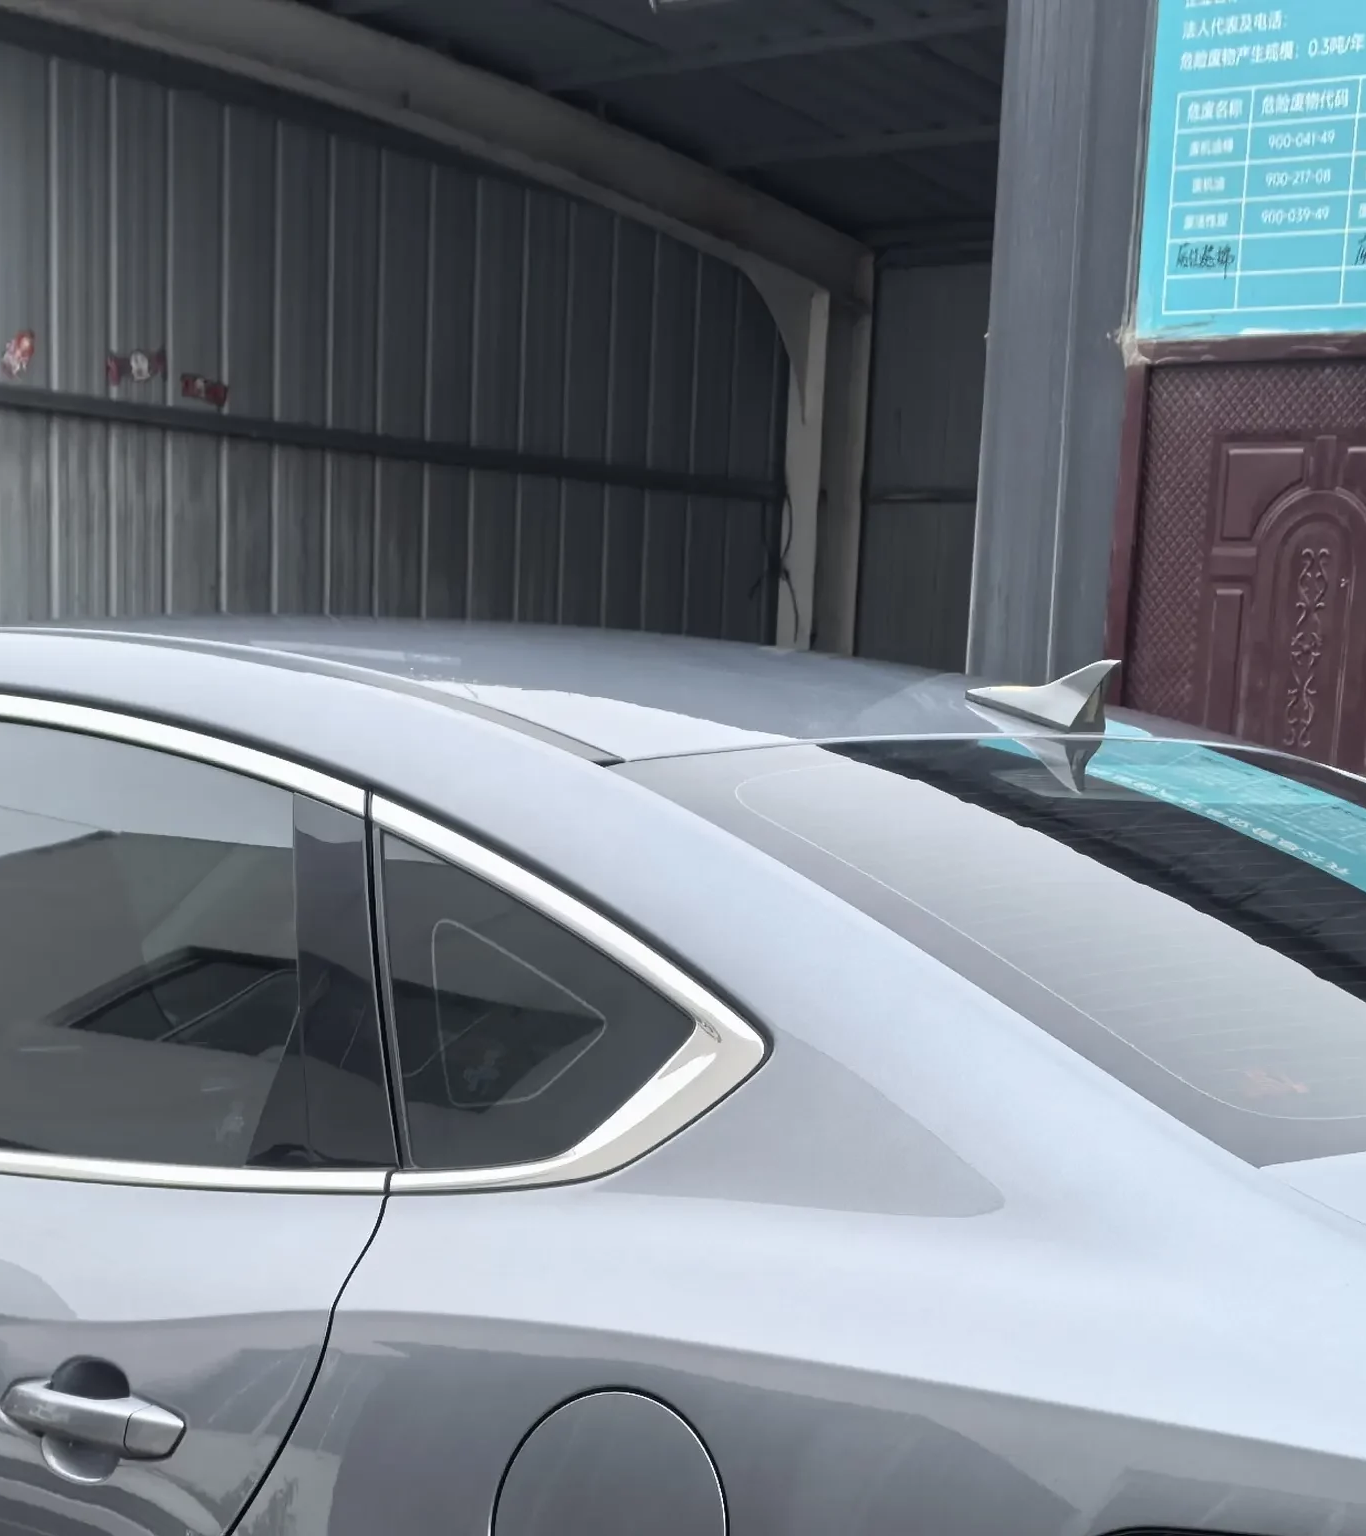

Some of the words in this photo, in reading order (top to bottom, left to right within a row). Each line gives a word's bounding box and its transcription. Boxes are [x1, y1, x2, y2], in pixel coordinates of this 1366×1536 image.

[1261, 88, 1349, 115] 危险废物代码
[1269, 129, 1335, 149] 900-041-49
[1261, 206, 1329, 225] 900-039-49
